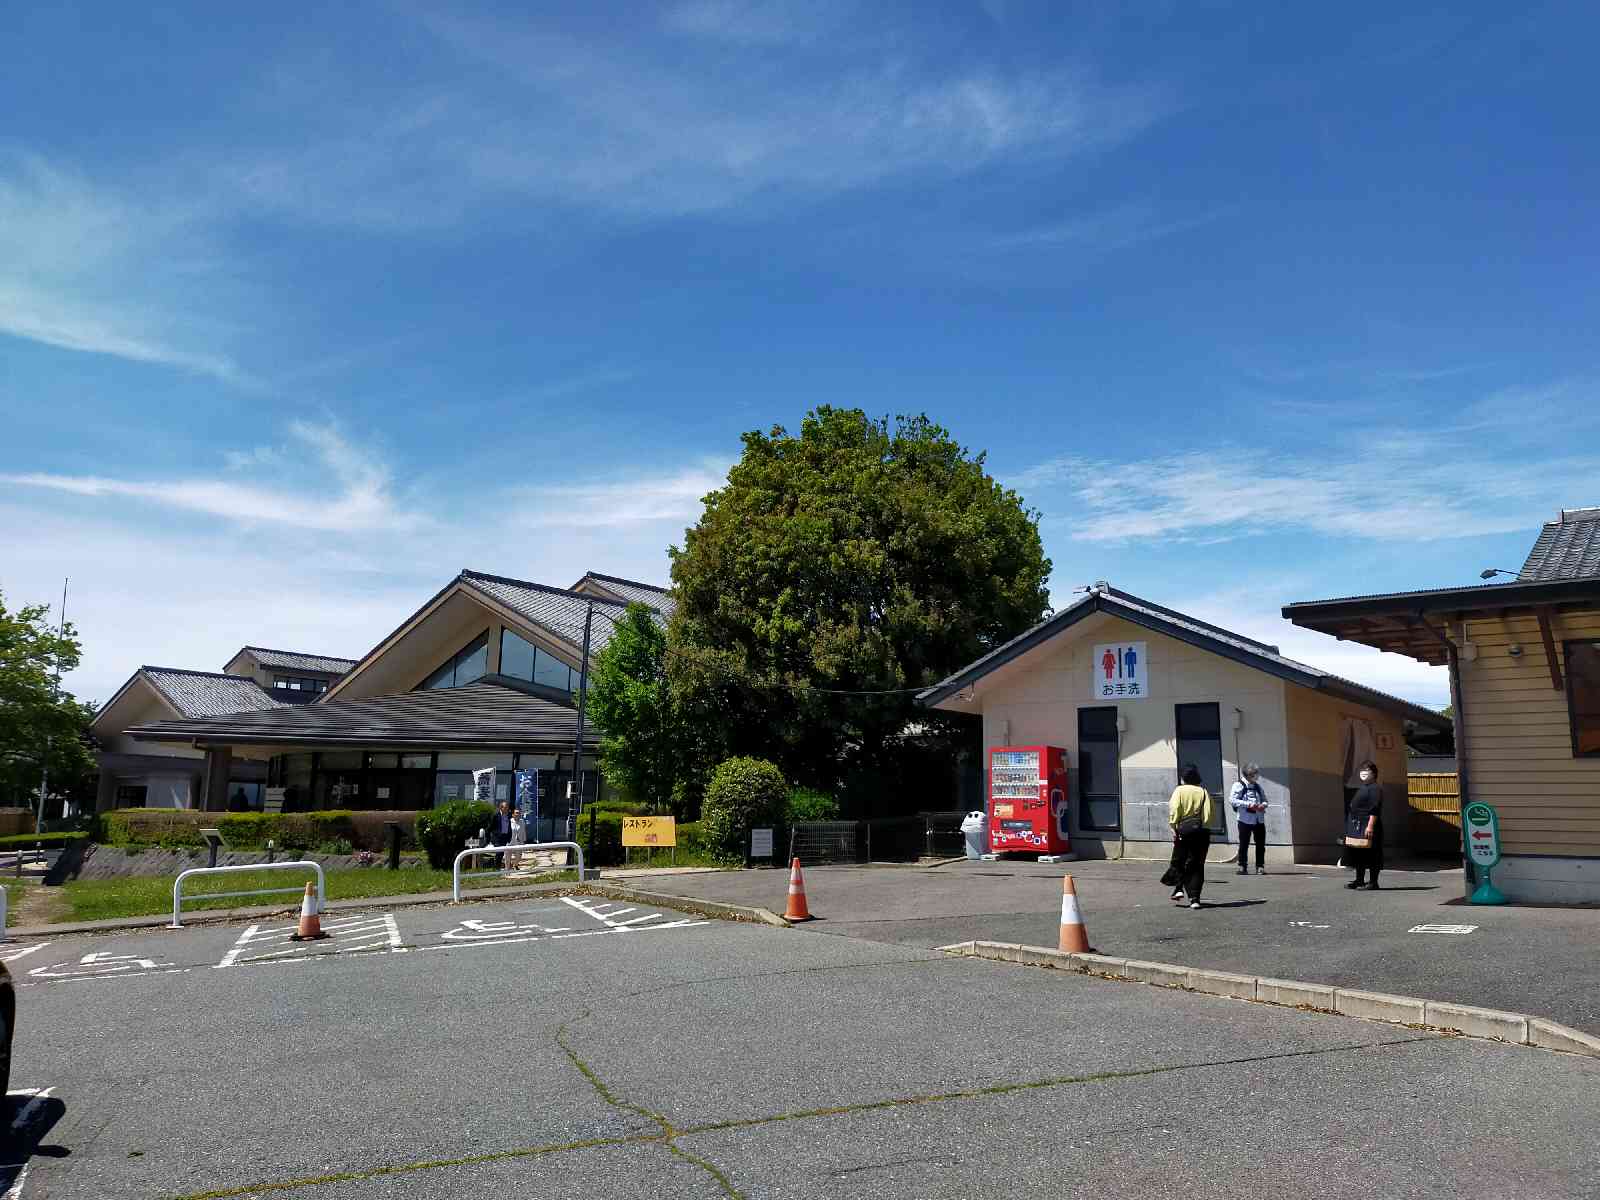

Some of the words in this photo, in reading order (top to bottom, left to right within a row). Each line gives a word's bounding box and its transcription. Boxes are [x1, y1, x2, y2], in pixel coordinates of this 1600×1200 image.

[1103, 682, 1141, 696] お手洗
[623, 819, 653, 829] レストラン
